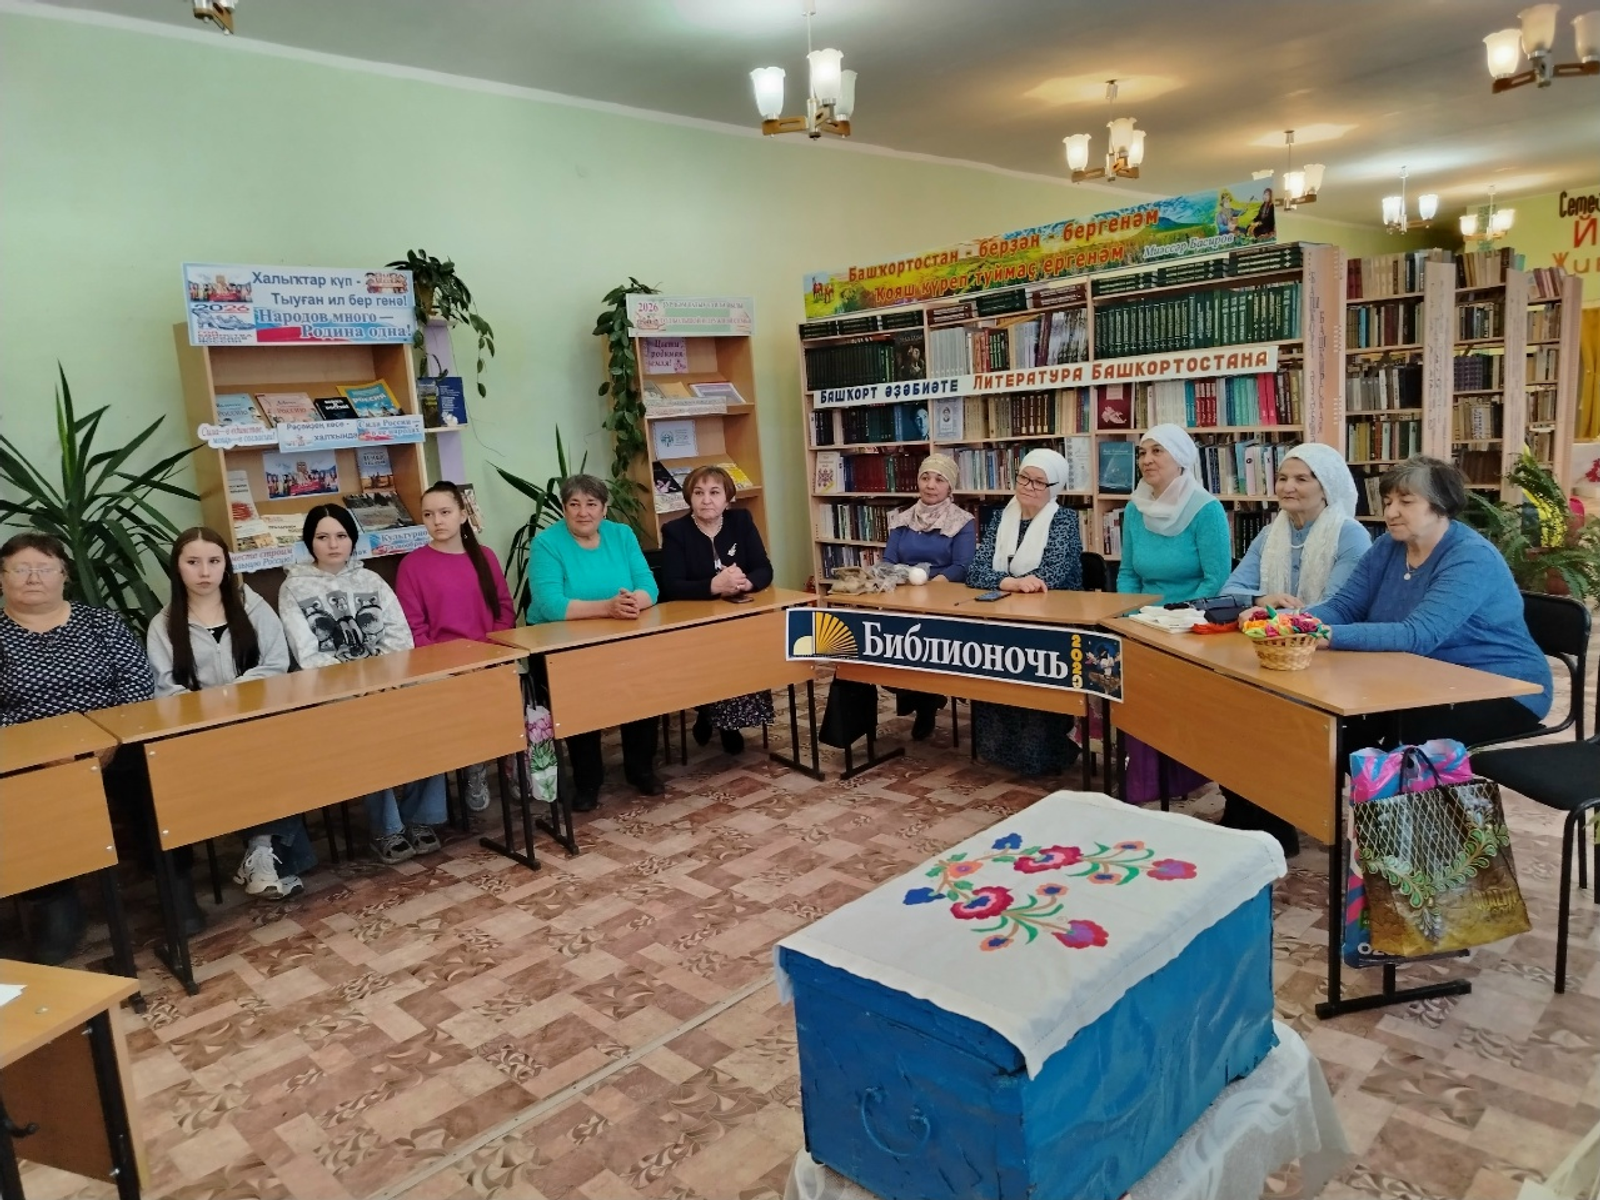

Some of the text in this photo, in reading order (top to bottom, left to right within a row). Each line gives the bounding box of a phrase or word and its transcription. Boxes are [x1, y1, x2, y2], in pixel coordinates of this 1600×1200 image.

[848, 248, 959, 282] Башҡортостан
[978, 233, 1040, 258] берҙән
[1064, 209, 1160, 242] бергенәм
[252, 272, 326, 288] Халыҡтар
[330, 276, 352, 289] күп
[875, 245, 1124, 302] Ҡояш күреп туймаҫ ергенәм
[195, 304, 250, 312] 2026
[272, 292, 326, 308] Тыуған
[328, 296, 346, 306] ил
[350, 294, 373, 308] бер
[638, 302, 658, 312] 2026
[260, 310, 328, 325] Народов
[334, 312, 376, 323] много
[302, 324, 412, 340] Родина одна!
[820, 352, 1268, 404] БАШҠОРТ ӘҘӘБИӘТЕ ЛИТЕРАТУРА БАШКОРТОСТАНА
[862, 620, 1068, 680] Библионочь
